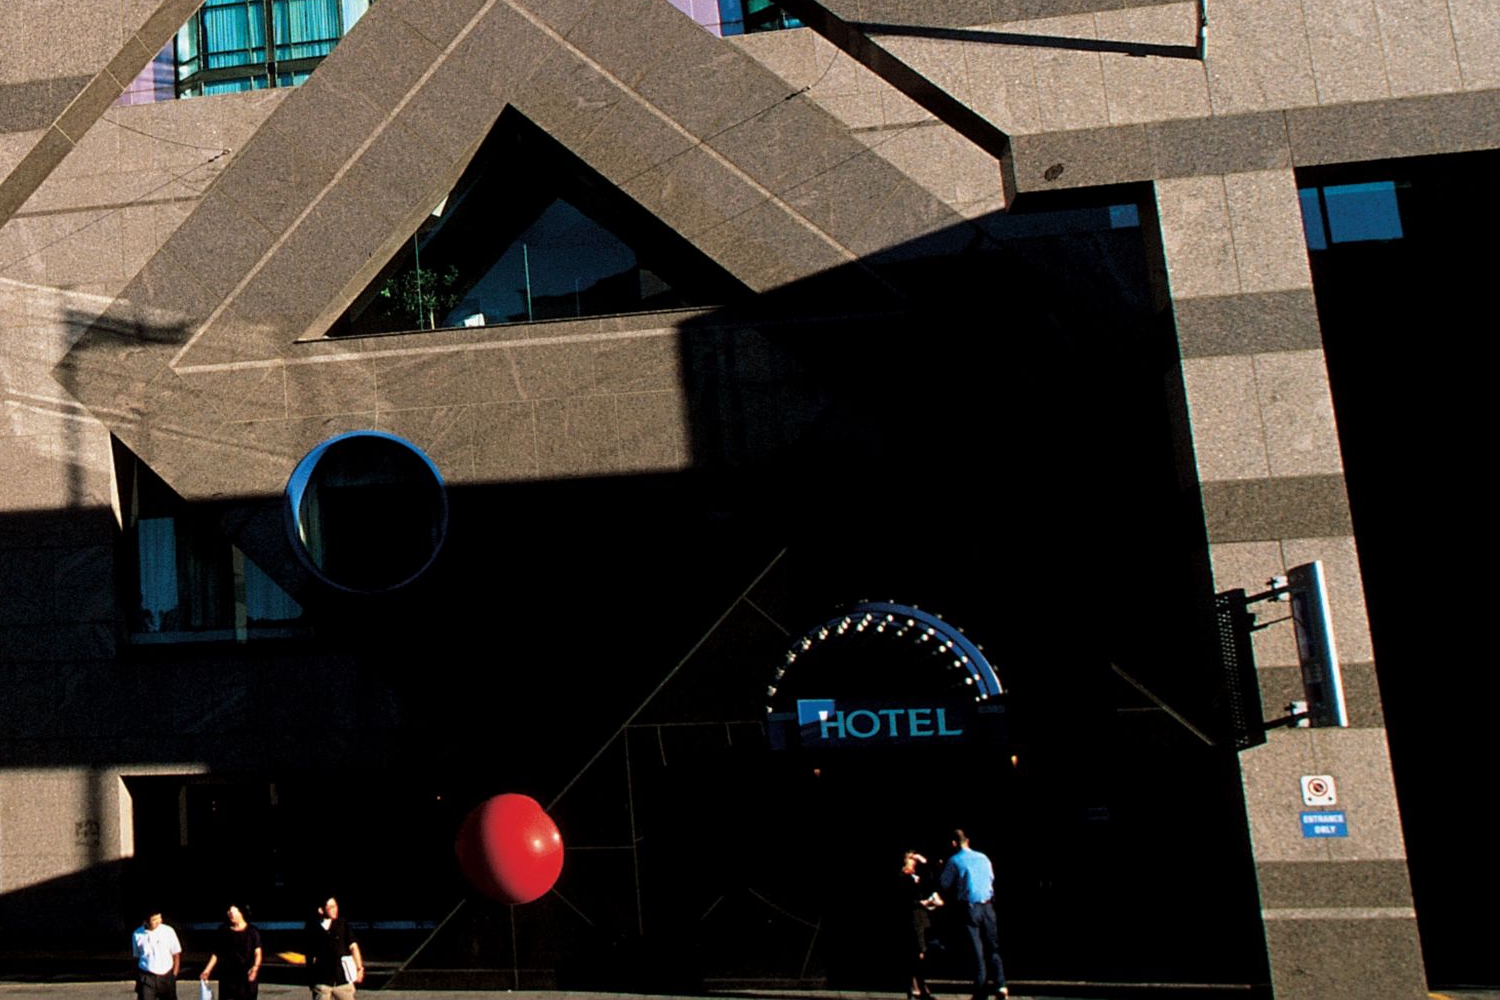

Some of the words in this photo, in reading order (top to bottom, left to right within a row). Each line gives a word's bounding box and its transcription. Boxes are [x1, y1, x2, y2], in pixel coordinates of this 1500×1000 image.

[818, 708, 964, 739] HOTEL
[1302, 814, 1345, 824] ENTRANCE
[1314, 825, 1336, 834] ONLY
